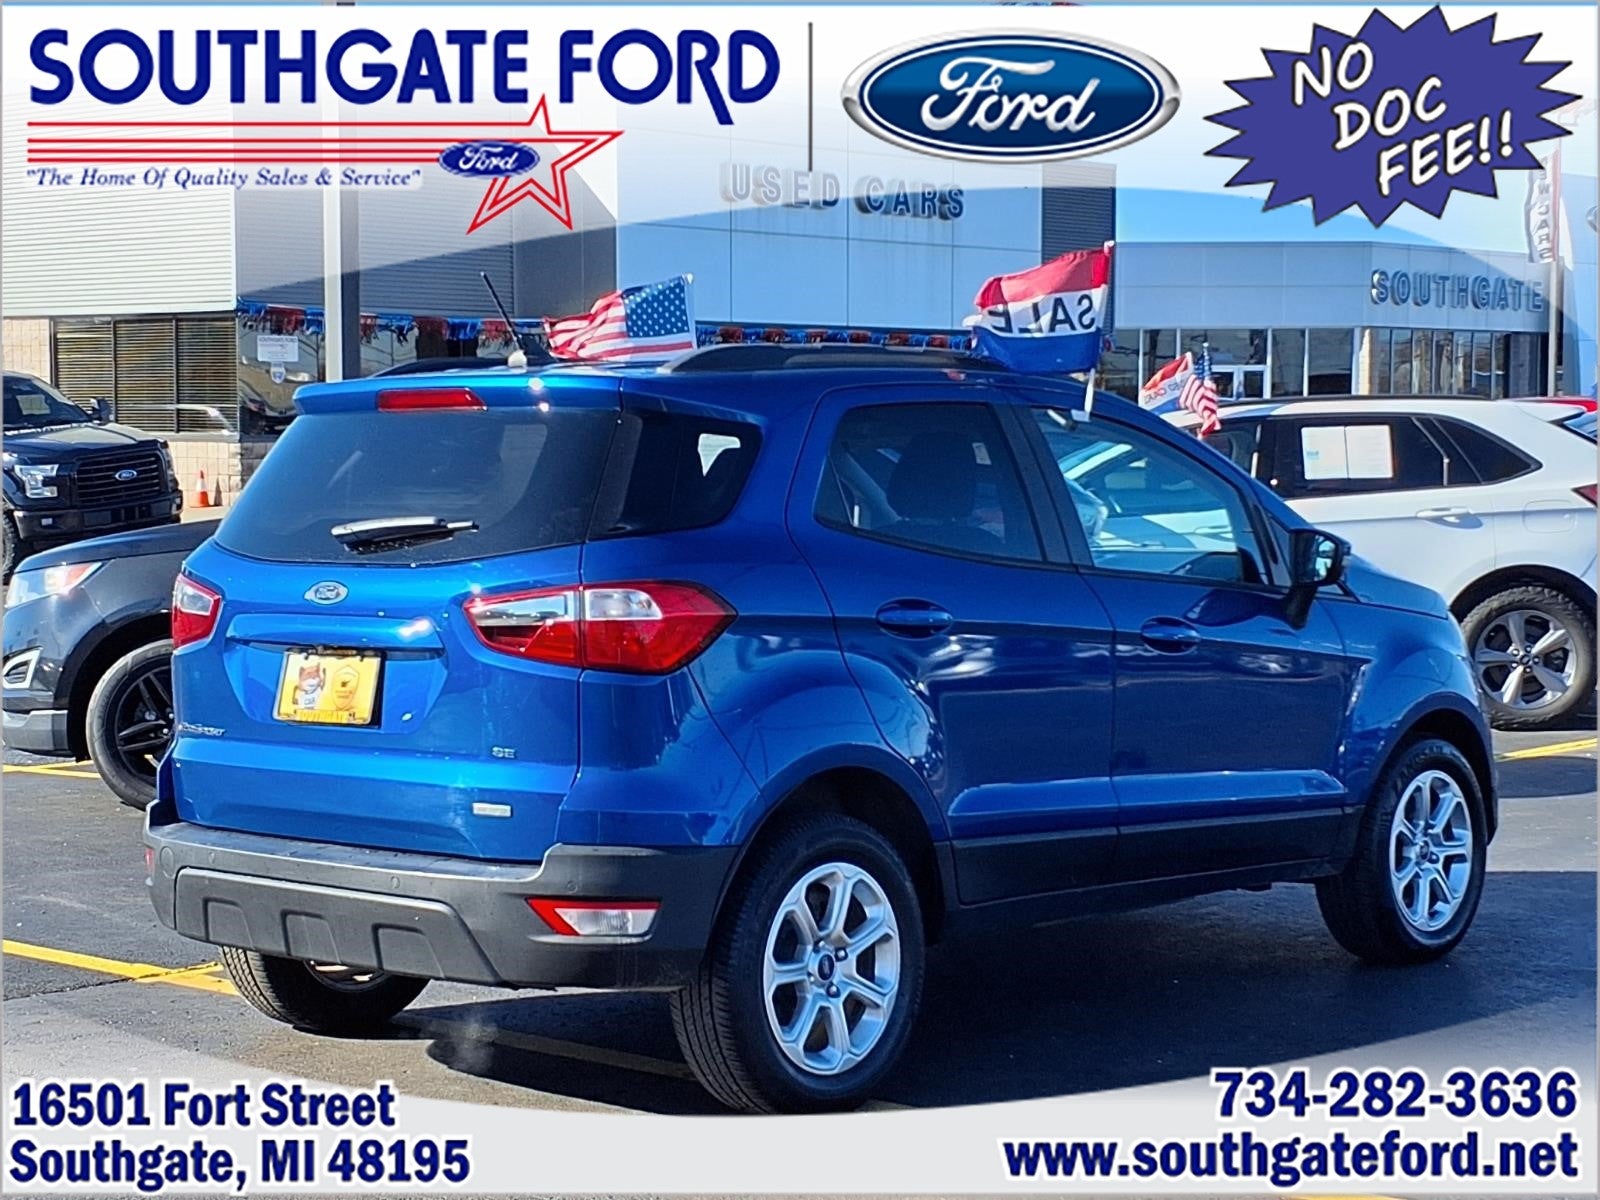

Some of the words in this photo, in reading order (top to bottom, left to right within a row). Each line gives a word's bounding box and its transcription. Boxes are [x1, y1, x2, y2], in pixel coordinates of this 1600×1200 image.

[721, 163, 841, 210] USED
[855, 175, 965, 220] CARS
[1371, 269, 1545, 312] SOUTHGATE
[491, 746, 516, 759] SE
